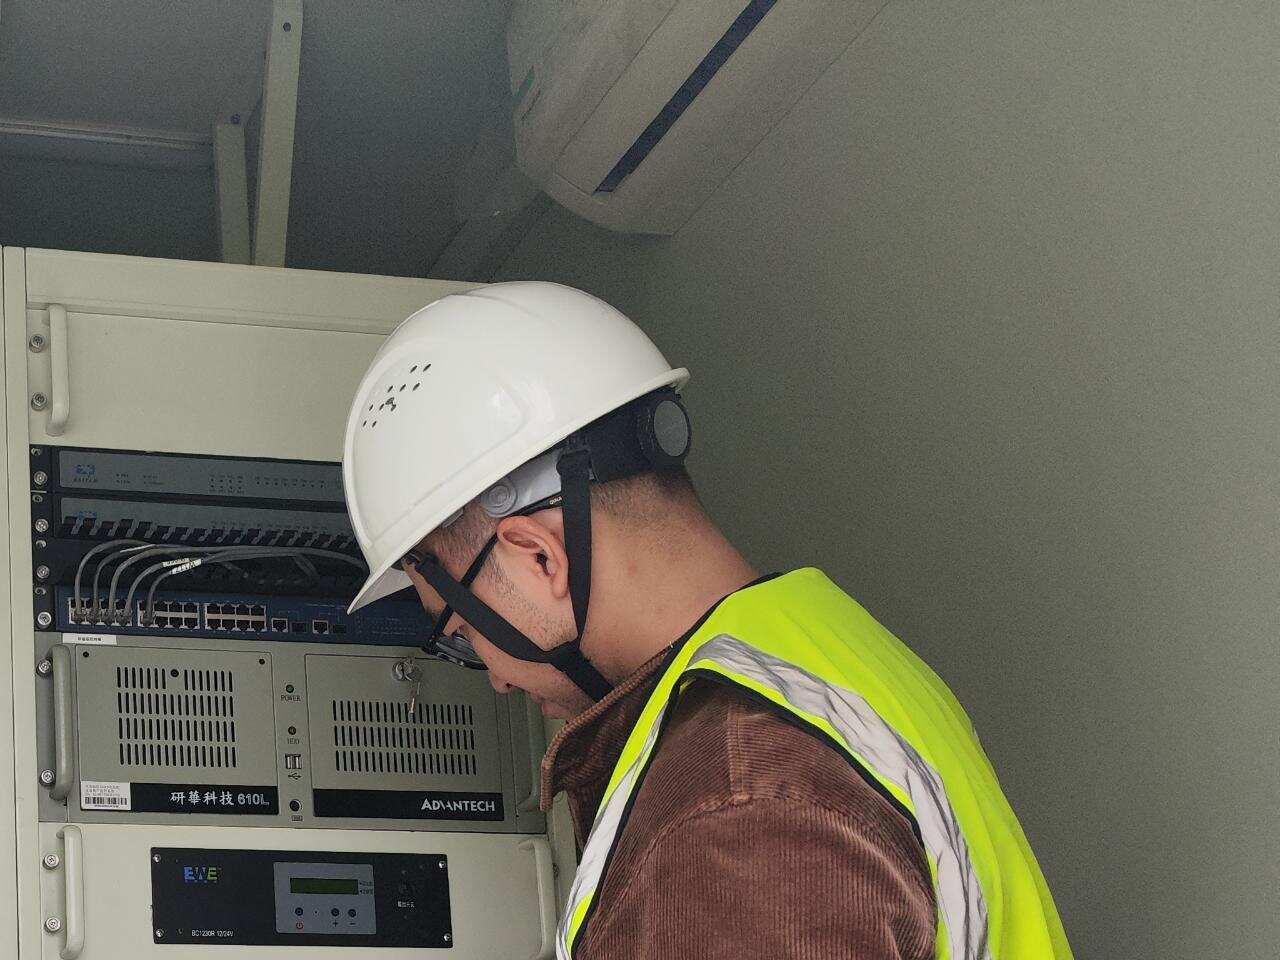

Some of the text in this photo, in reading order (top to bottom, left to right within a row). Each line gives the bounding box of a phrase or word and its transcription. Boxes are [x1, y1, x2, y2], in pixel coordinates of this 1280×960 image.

[169, 790, 270, 806] 研華科技 610L
[420, 798, 496, 812] ADVANTECH
